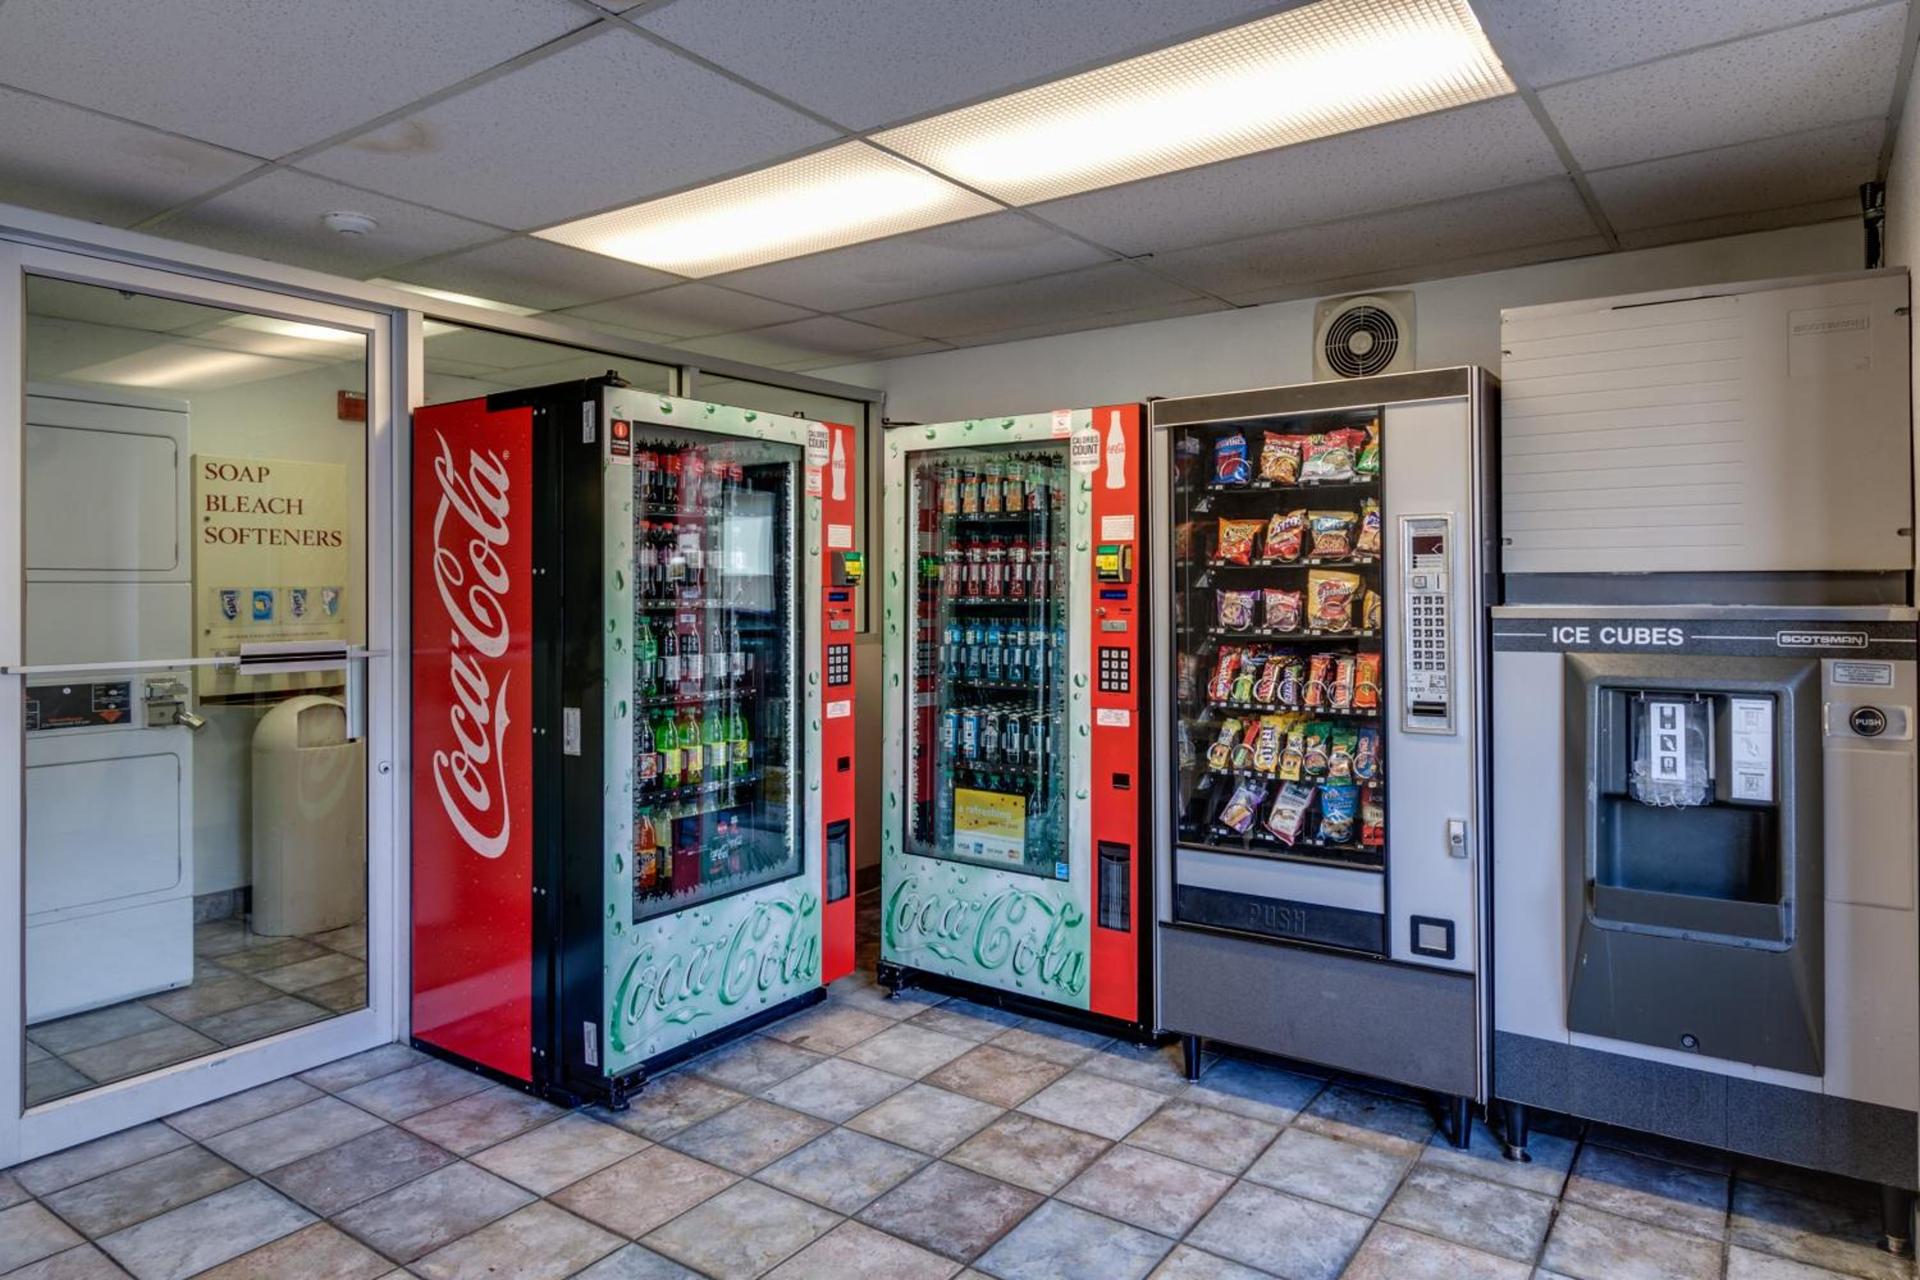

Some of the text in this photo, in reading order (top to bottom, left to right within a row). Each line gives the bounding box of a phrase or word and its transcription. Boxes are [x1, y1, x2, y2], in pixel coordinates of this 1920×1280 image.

[1072, 444, 1098, 456] COUNT
[204, 462, 270, 483] SOAP
[205, 494, 304, 515] BLEACH
[204, 526, 343, 547] SOFTENERS
[432, 427, 511, 859] Coca-Cola
[1552, 626, 1684, 646] ICE CUBES
[1781, 634, 1864, 646] SCOTSMAN
[1855, 718, 1882, 726] PUSH
[1248, 902, 1307, 934] PUSH
